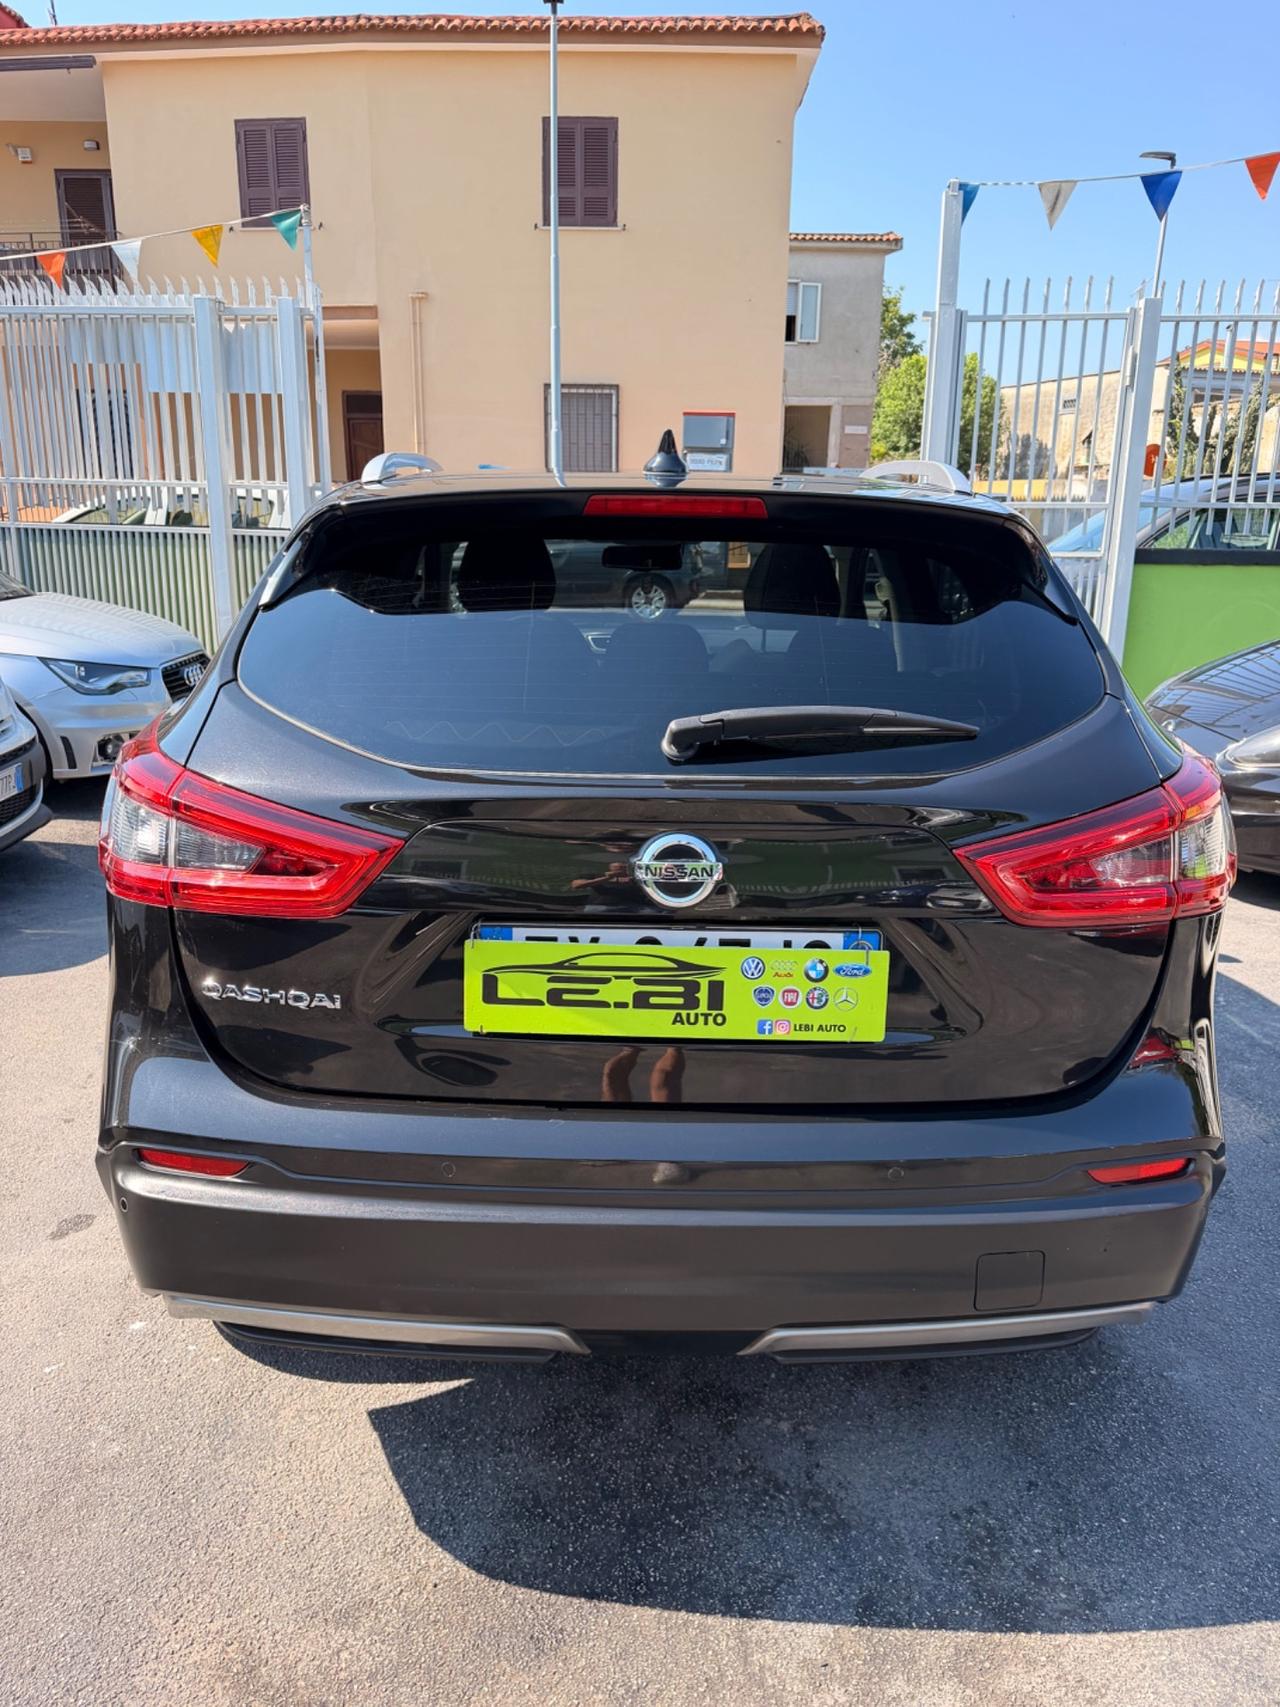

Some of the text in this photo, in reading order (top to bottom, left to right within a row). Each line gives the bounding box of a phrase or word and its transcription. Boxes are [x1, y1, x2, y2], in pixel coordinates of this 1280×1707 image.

[644, 864, 714, 878] NISSAN
[840, 966, 865, 976] Ford
[202, 981, 342, 1010] QASHQAI
[671, 1012, 727, 1027] AUTO
[793, 1023, 847, 1033] LEBI AUTO
